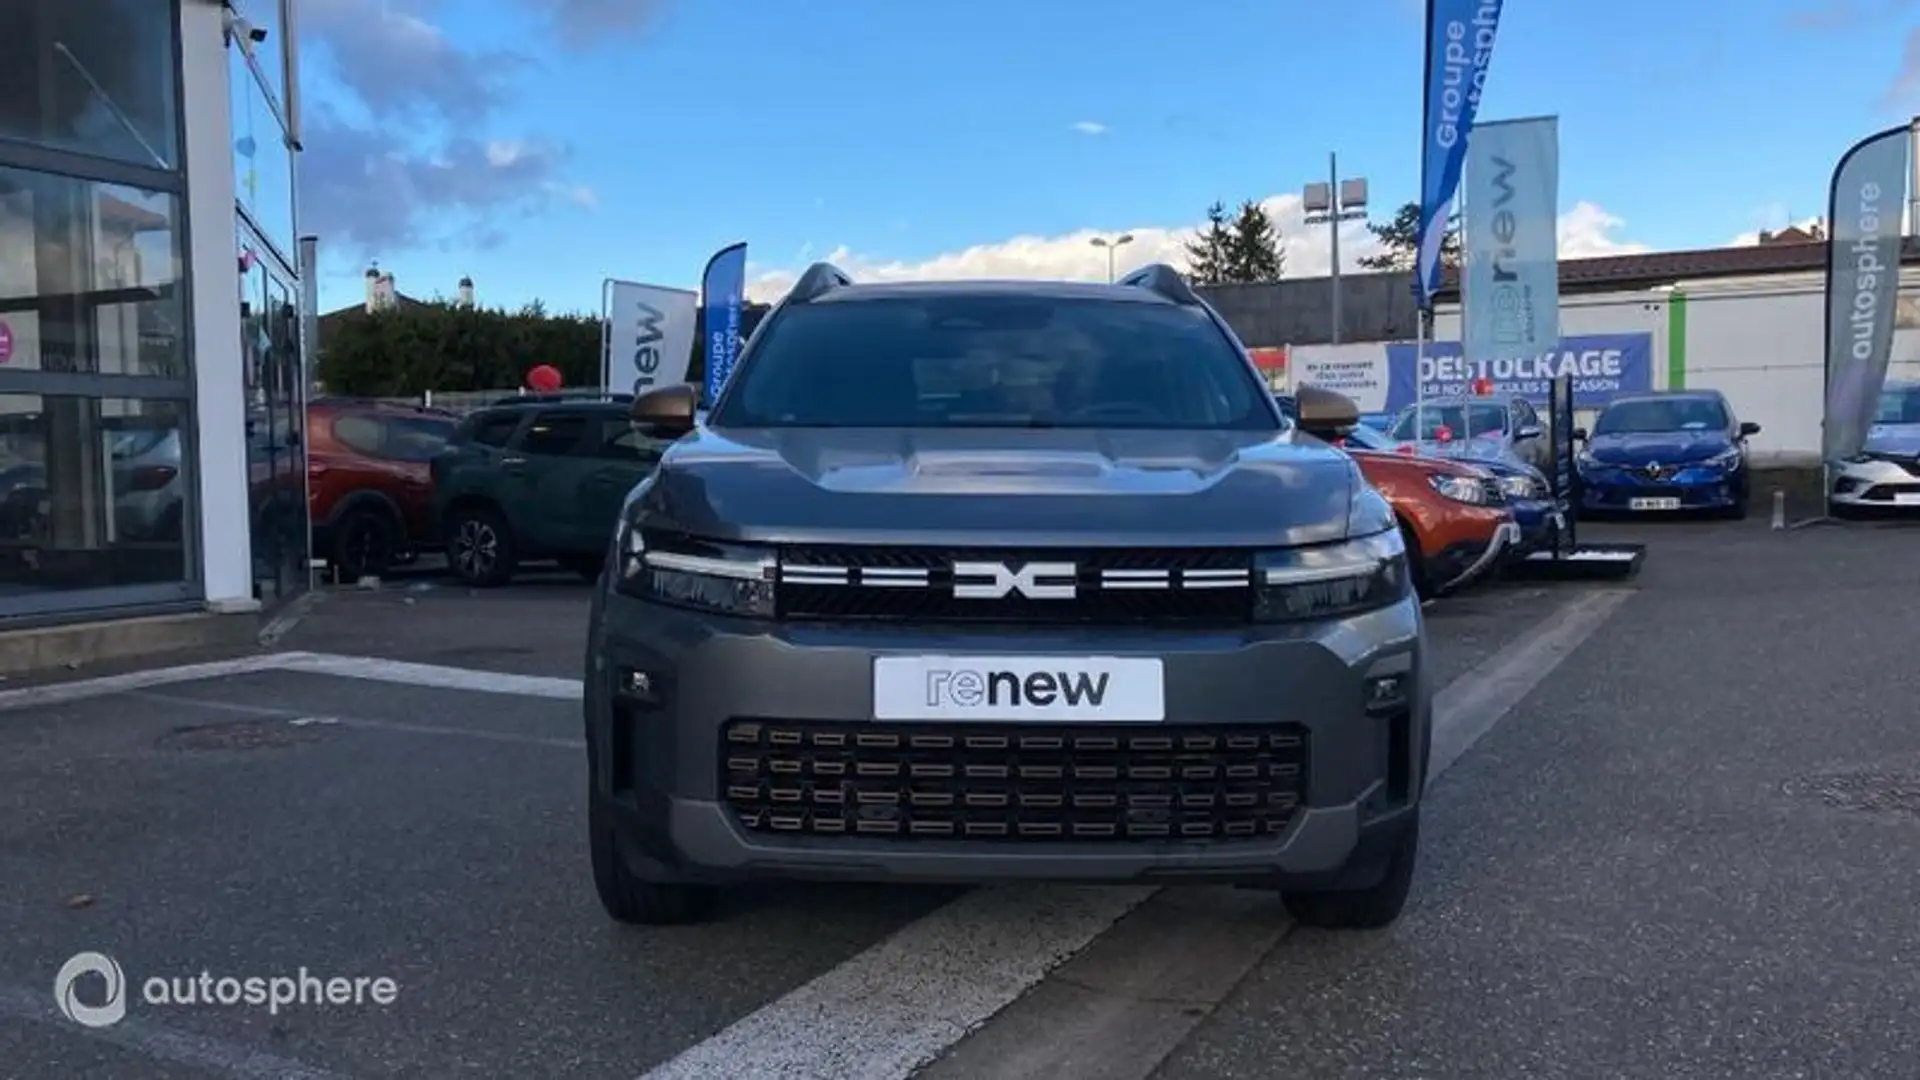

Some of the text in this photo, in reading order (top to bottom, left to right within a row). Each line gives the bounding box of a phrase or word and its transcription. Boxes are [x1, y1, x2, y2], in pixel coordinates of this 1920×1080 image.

[1437, 20, 1471, 148] Groupe
[1852, 181, 1886, 360] autosphere
[926, 669, 1110, 706] renew
